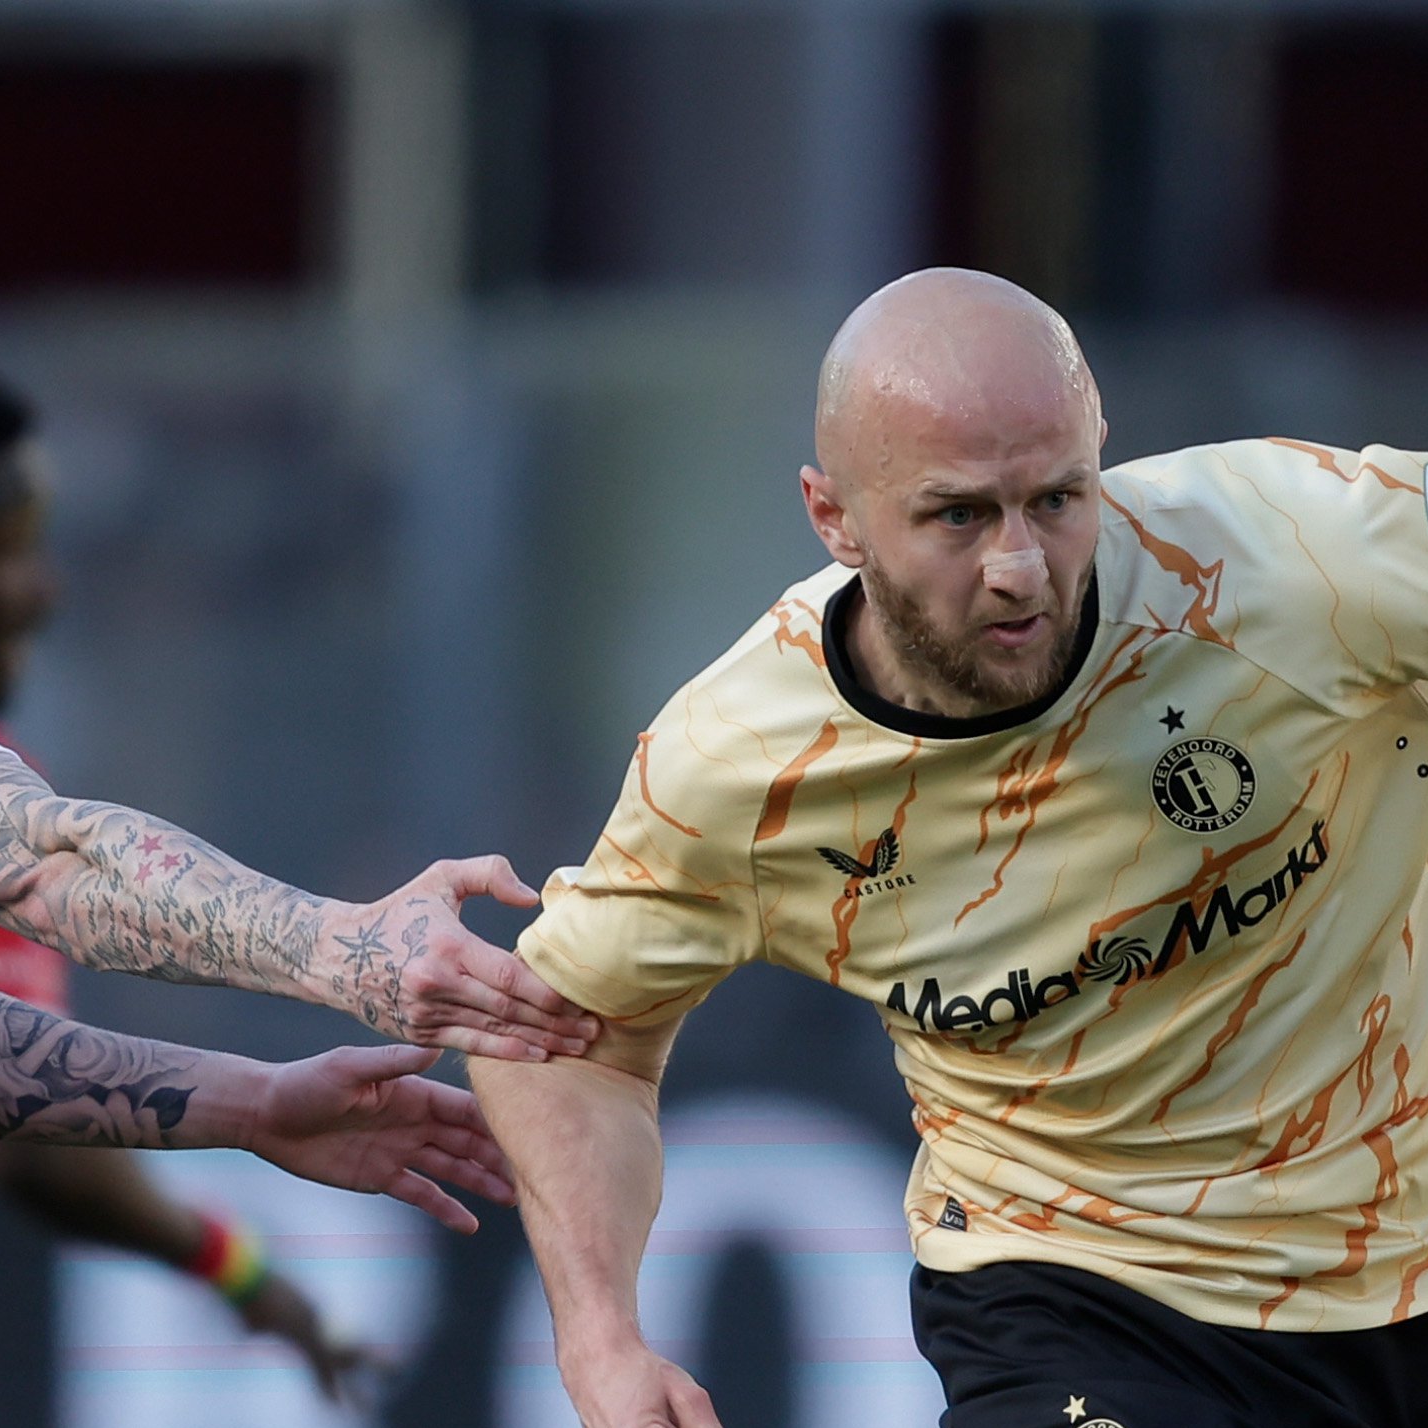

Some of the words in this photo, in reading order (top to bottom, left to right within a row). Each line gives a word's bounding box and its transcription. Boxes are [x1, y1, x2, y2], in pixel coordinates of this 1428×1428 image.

[1154, 740, 1237, 788] FEYENOORD
[1170, 780, 1254, 831] ROTTERDAM
[844, 874, 916, 899] CASTORE
[886, 967, 1080, 1034] Media
[1153, 819, 1331, 975] Markt
